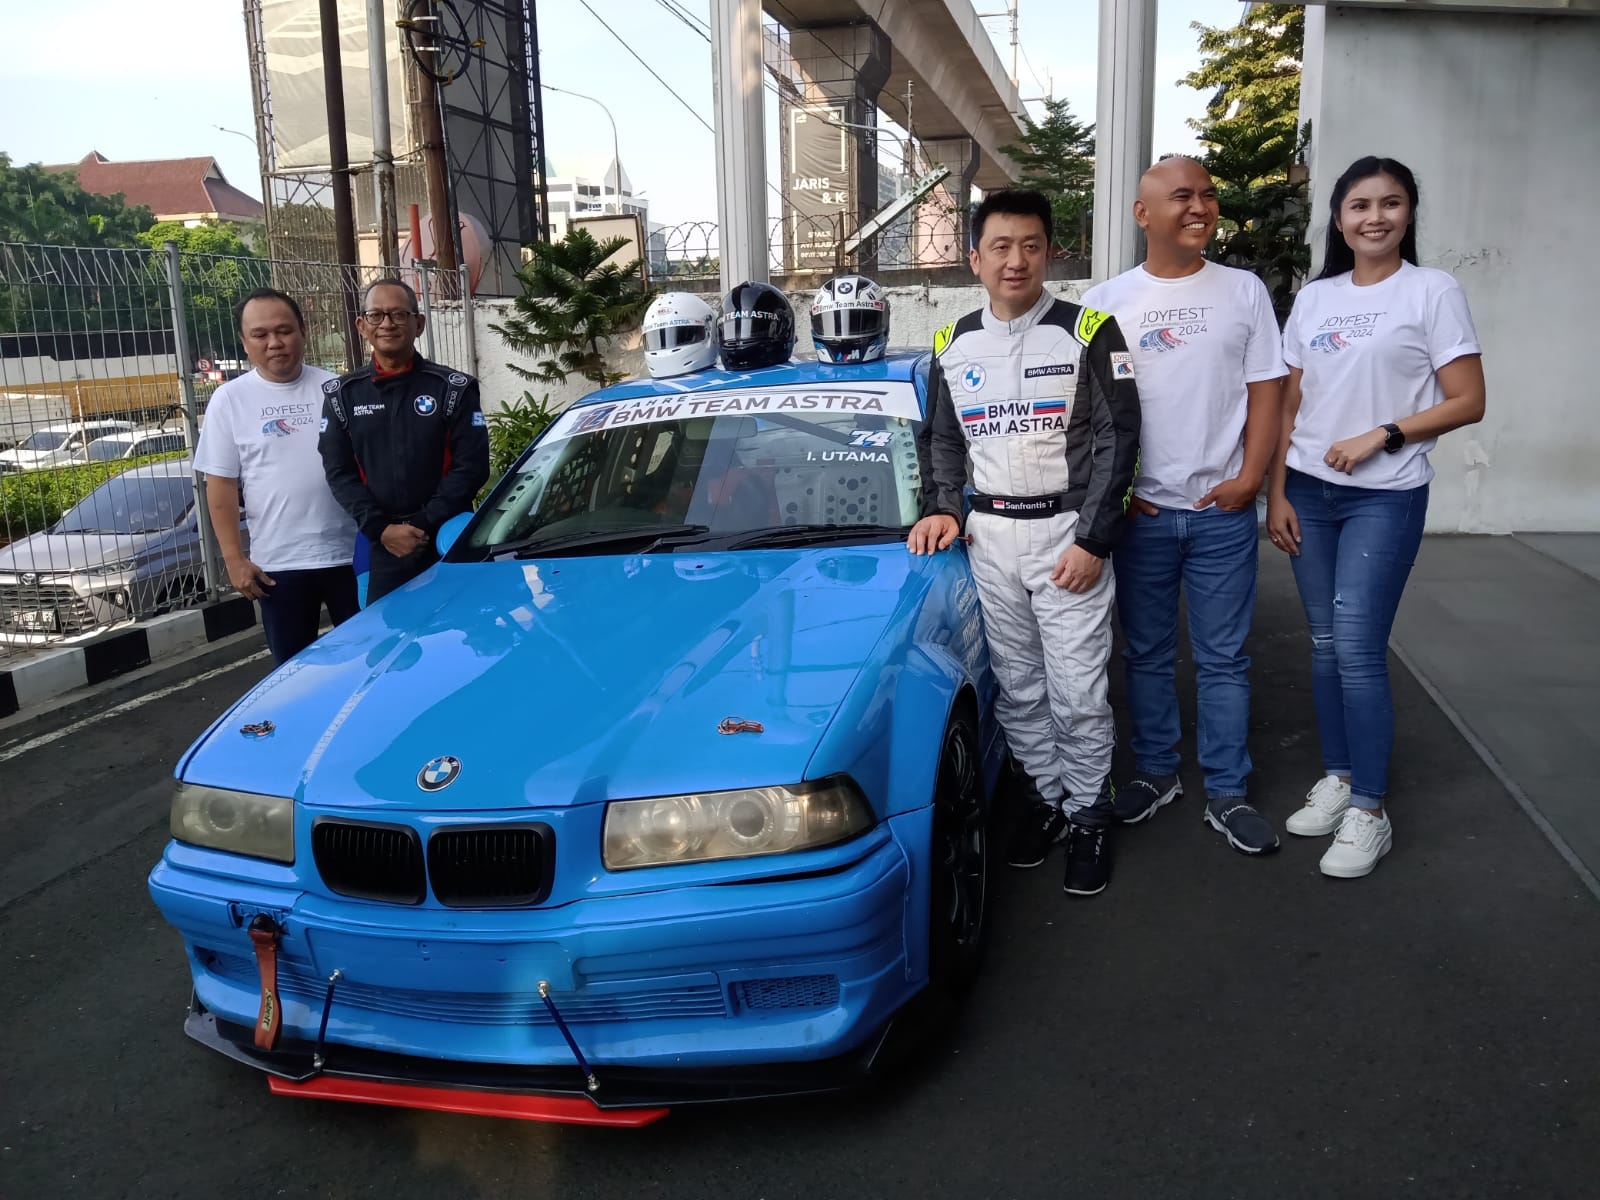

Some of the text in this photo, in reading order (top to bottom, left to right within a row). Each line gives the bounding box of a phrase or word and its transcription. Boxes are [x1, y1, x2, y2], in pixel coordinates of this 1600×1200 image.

[793, 178, 830, 190] JARIS
[822, 192, 832, 203] &
[726, 310, 779, 320] TEAM ASTRA
[1140, 307, 1209, 324] JOYFEST
[1319, 313, 1381, 328] JOYFEST
[1178, 324, 1208, 336] 2024
[1346, 329, 1374, 338] 2024
[1027, 365, 1072, 376] BMW ASTRA
[261, 403, 312, 416] JOYFEST
[611, 404, 682, 424] BMW
[689, 396, 771, 414] TEAM
[777, 395, 884, 412] ASTRA
[617, 395, 688, 411] JAHRE
[988, 402, 1031, 419] BMW
[291, 416, 313, 425] 2024
[965, 416, 1065, 438] TEAM ASTRA
[848, 430, 893, 447] 74
[807, 451, 890, 464] I. UTAMA
[1048, 500, 1055, 508] T
